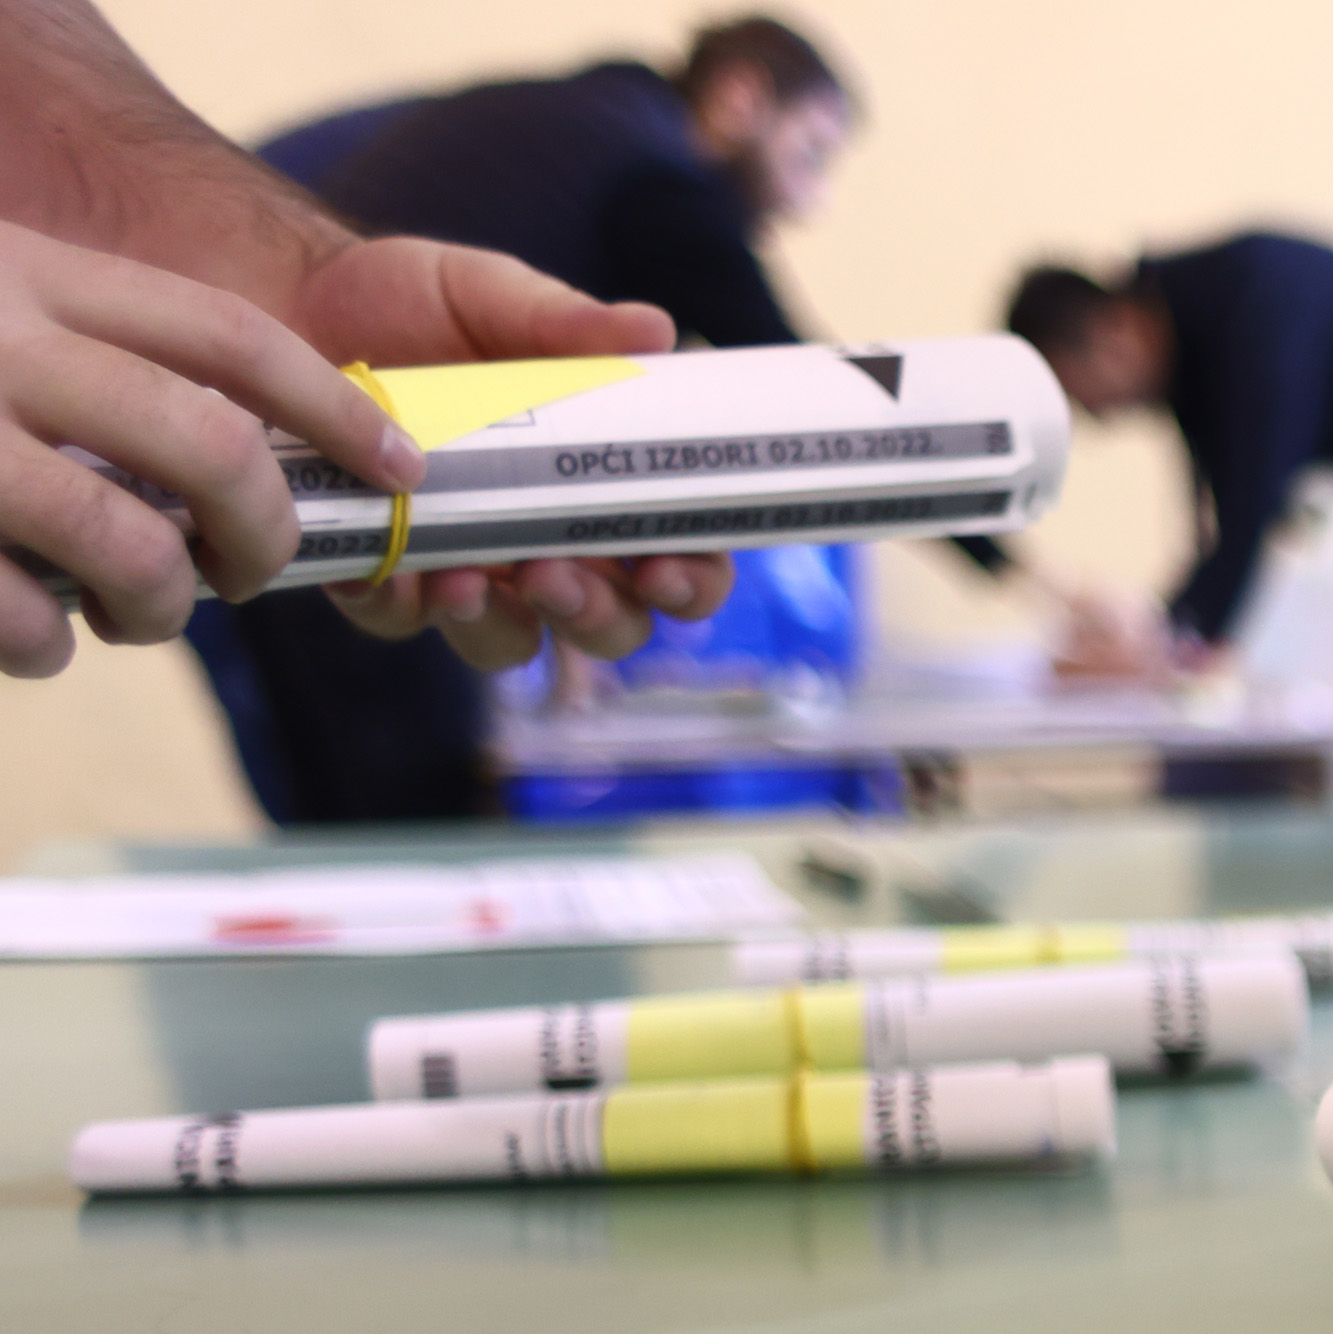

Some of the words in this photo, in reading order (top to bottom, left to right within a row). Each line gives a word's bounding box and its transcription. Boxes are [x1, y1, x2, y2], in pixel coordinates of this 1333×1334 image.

[555, 443, 635, 477] OPĆI
[646, 440, 758, 472] IZBORI
[768, 431, 944, 464] 02.10.2022.
